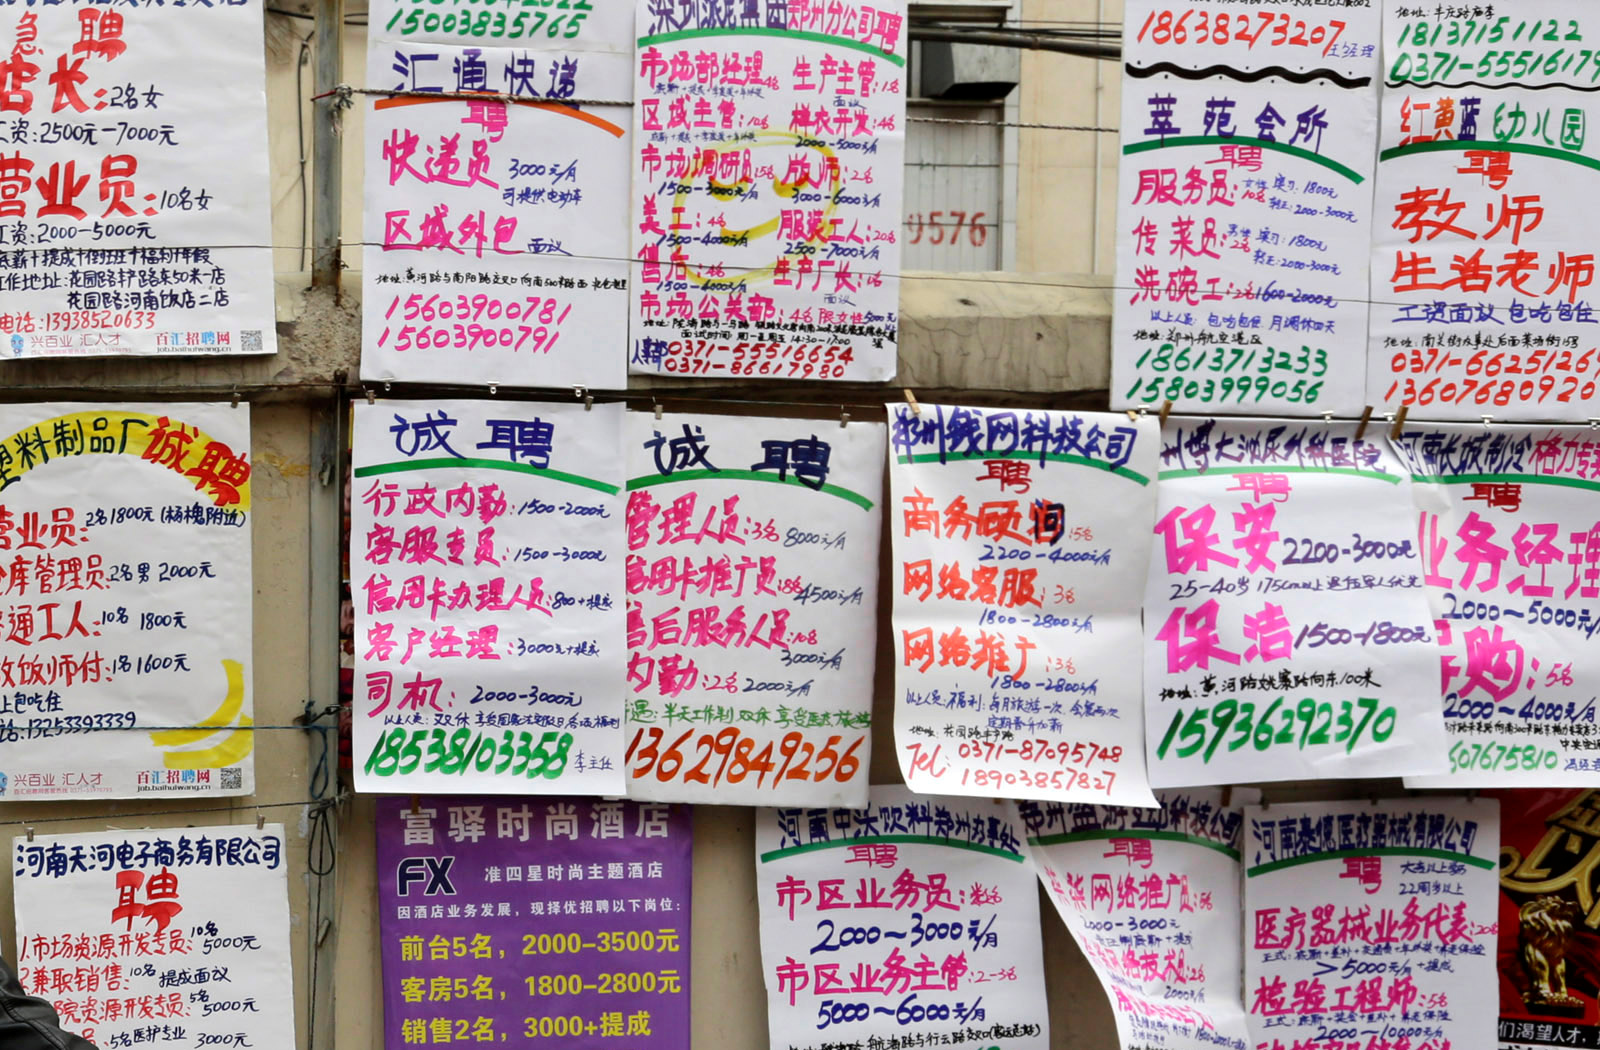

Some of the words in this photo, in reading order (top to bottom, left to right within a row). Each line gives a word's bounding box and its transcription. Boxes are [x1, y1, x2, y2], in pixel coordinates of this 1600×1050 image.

[386, 10, 589, 40] 15003835765
[1137, 10, 1346, 59] 18638273207
[1397, 16, 1583, 49] 18137151122
[392, 50, 580, 102] 汇通快递
[383, 128, 499, 189] 快递员
[1391, 186, 1544, 245] 教师
[1389, 248, 1595, 303] 生活老师
[386, 295, 571, 327] 15603900781
[377, 325, 560, 354] 15603900791
[1135, 345, 1328, 373] 18613713233
[1126, 377, 1323, 405] 15803999056
[1153, 501, 1281, 577] 保安
[1154, 600, 1293, 674] 保洁
[365, 728, 575, 779] 18538103358
[1155, 698, 1397, 764] 15936292370
[14, 773, 53, 786] 兴百业
[62, 772, 103, 784] 汇人才
[136, 770, 211, 784] 百汇招聘网
[401, 802, 670, 845] 富驿时尚酒店
[484, 861, 664, 883] 准四星时尚主题酒店
